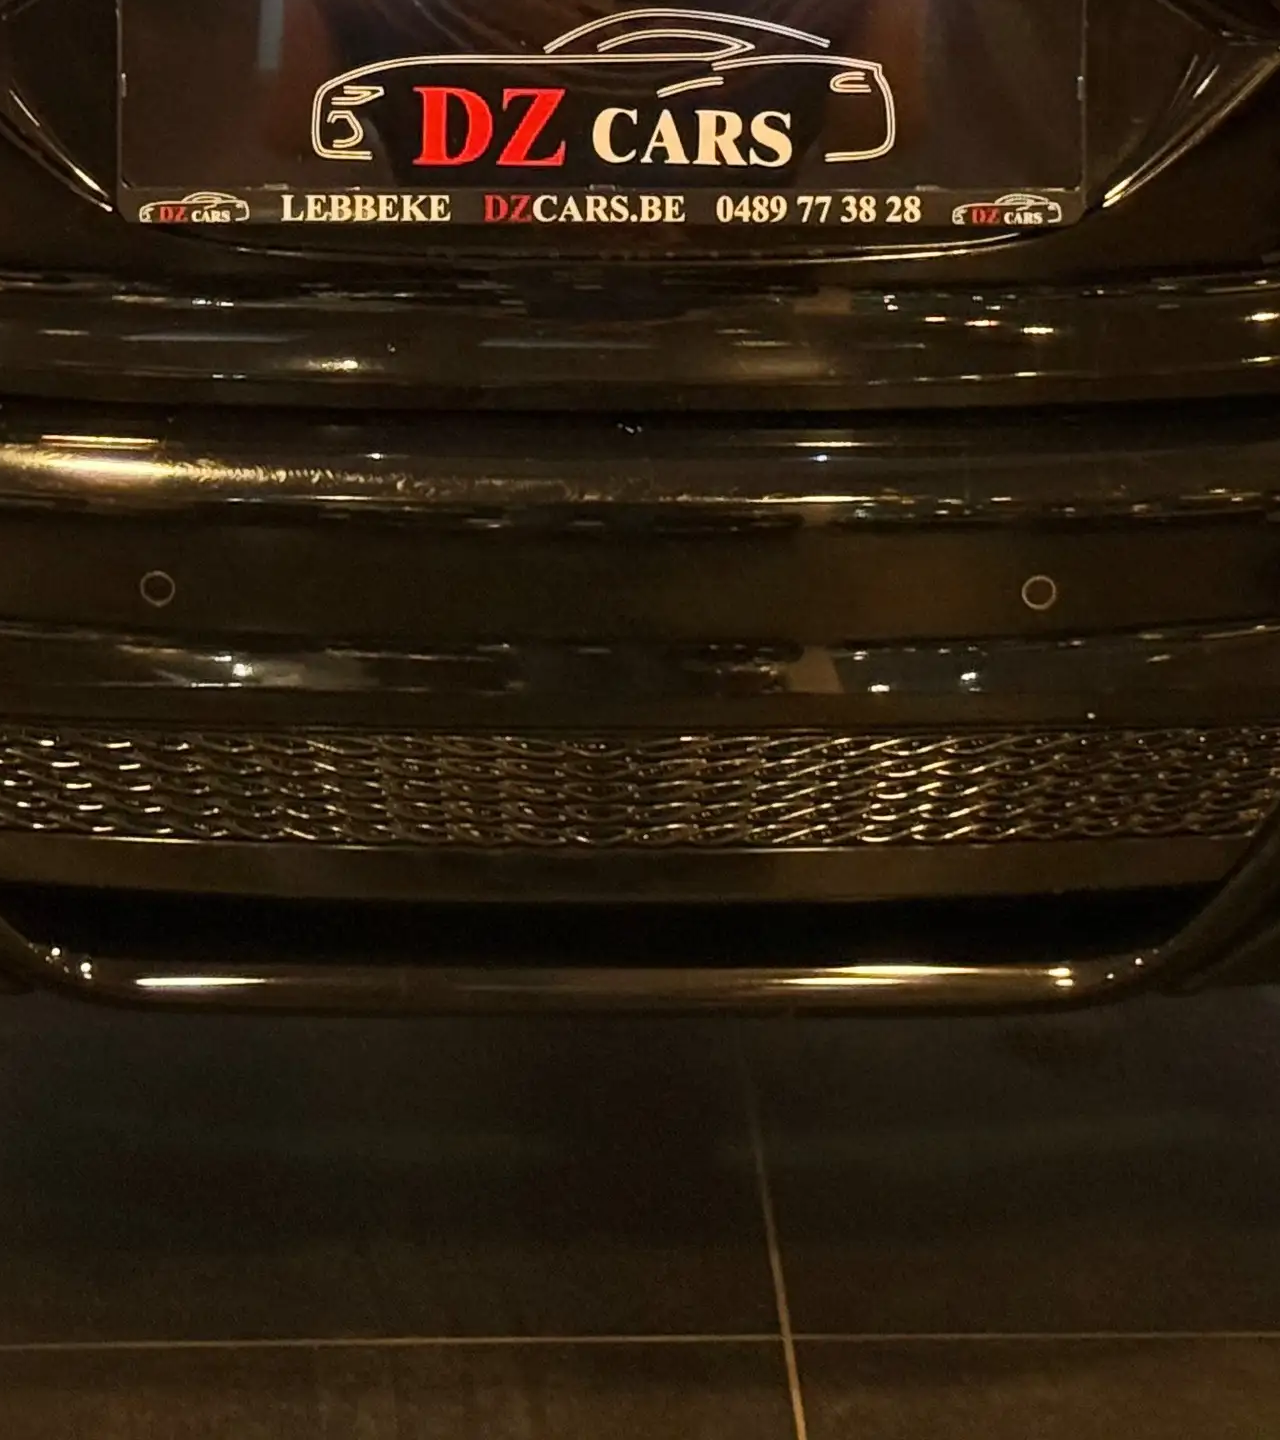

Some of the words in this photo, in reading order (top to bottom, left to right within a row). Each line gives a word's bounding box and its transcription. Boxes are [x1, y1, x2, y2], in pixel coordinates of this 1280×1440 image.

[412, 86, 567, 167] DZ
[591, 106, 794, 168] CARS
[158, 205, 187, 224] DZ
[190, 208, 231, 224] CARS
[280, 193, 452, 223] LEBBEKE
[483, 193, 686, 224] DZCARS.BE
[715, 194, 788, 224] 0489
[796, 194, 830, 224] 77
[839, 194, 874, 224] 38
[884, 194, 922, 224] 28
[971, 206, 1000, 225] DZ
[1003, 209, 1044, 226] CARS
